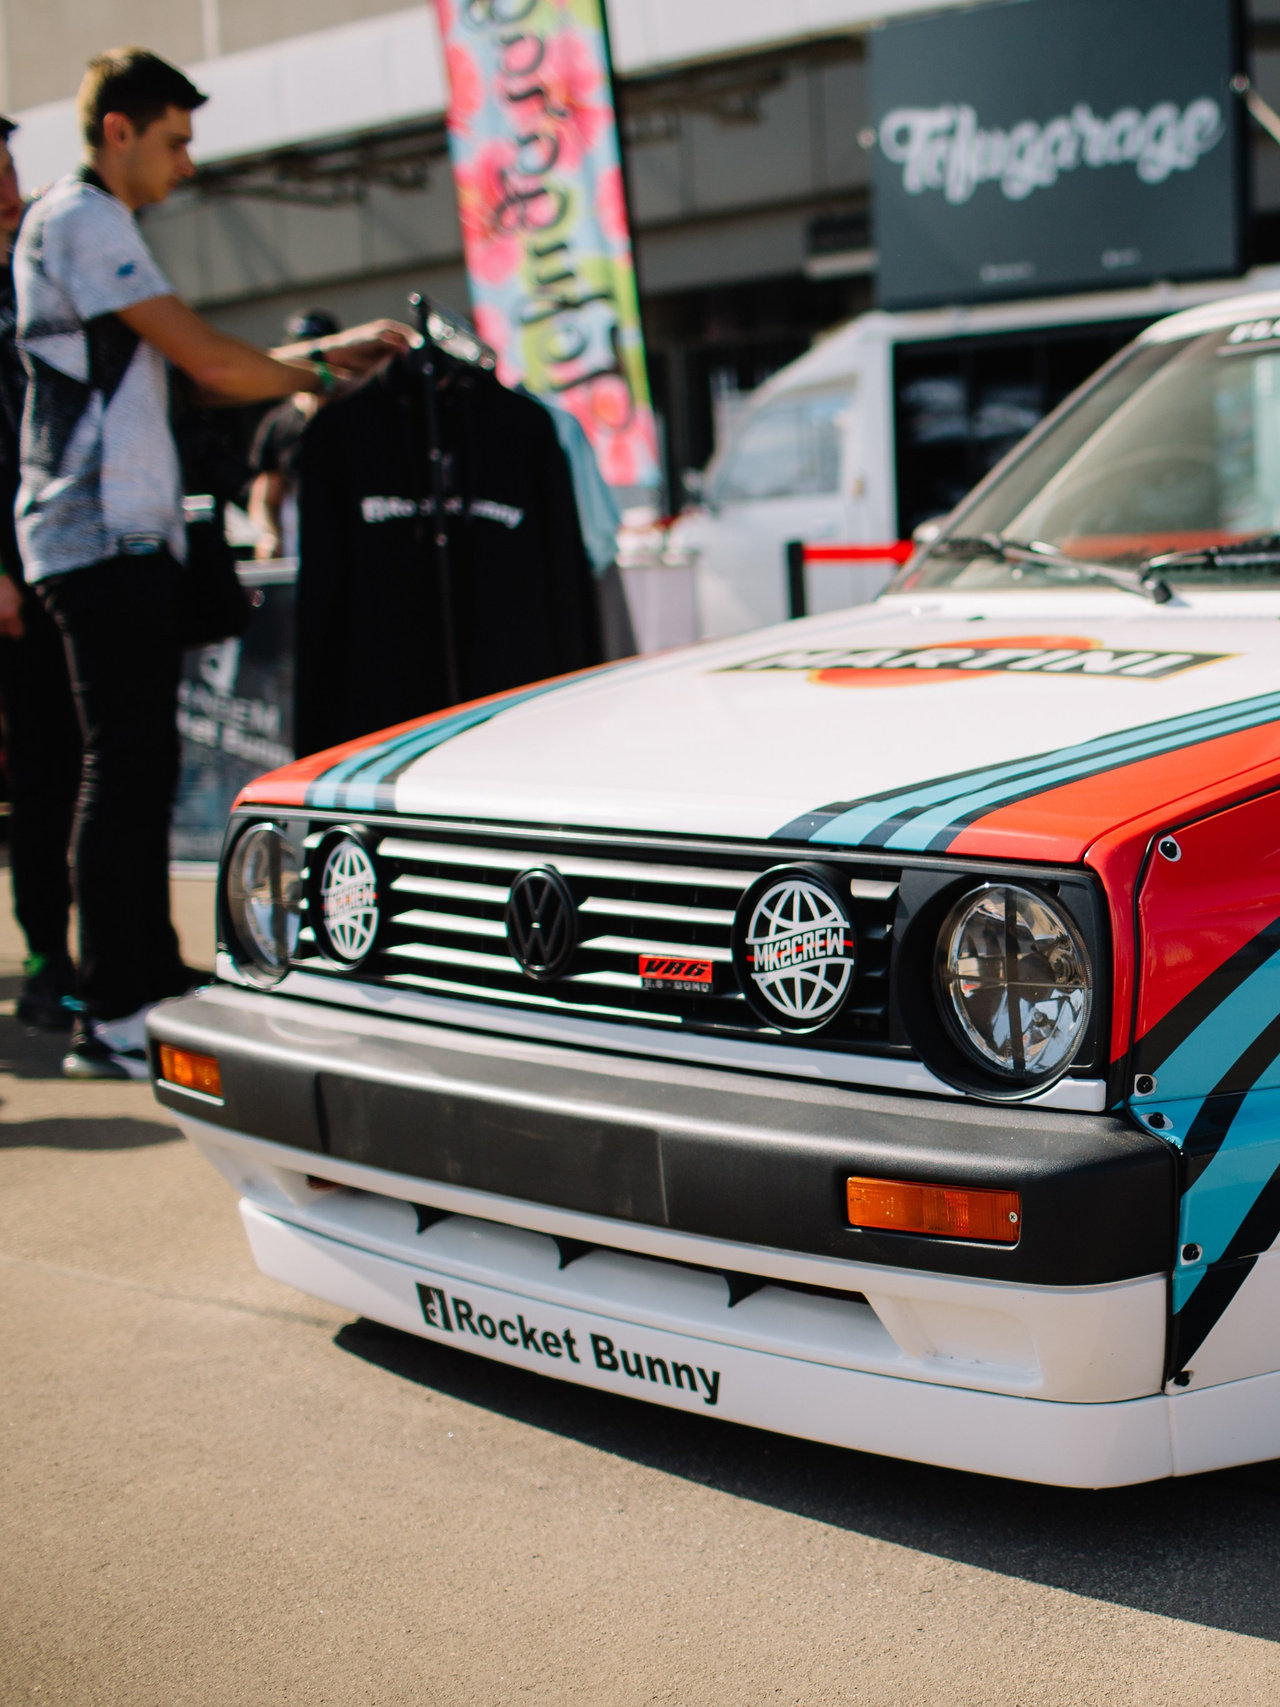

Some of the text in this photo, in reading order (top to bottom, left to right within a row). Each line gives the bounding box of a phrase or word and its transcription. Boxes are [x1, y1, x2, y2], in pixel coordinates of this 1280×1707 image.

[745, 647, 1193, 677] MARTINI
[754, 928, 844, 971] MK2CREW
[644, 960, 709, 977] VR6
[452, 1297, 721, 1405] Rocket Bunny
